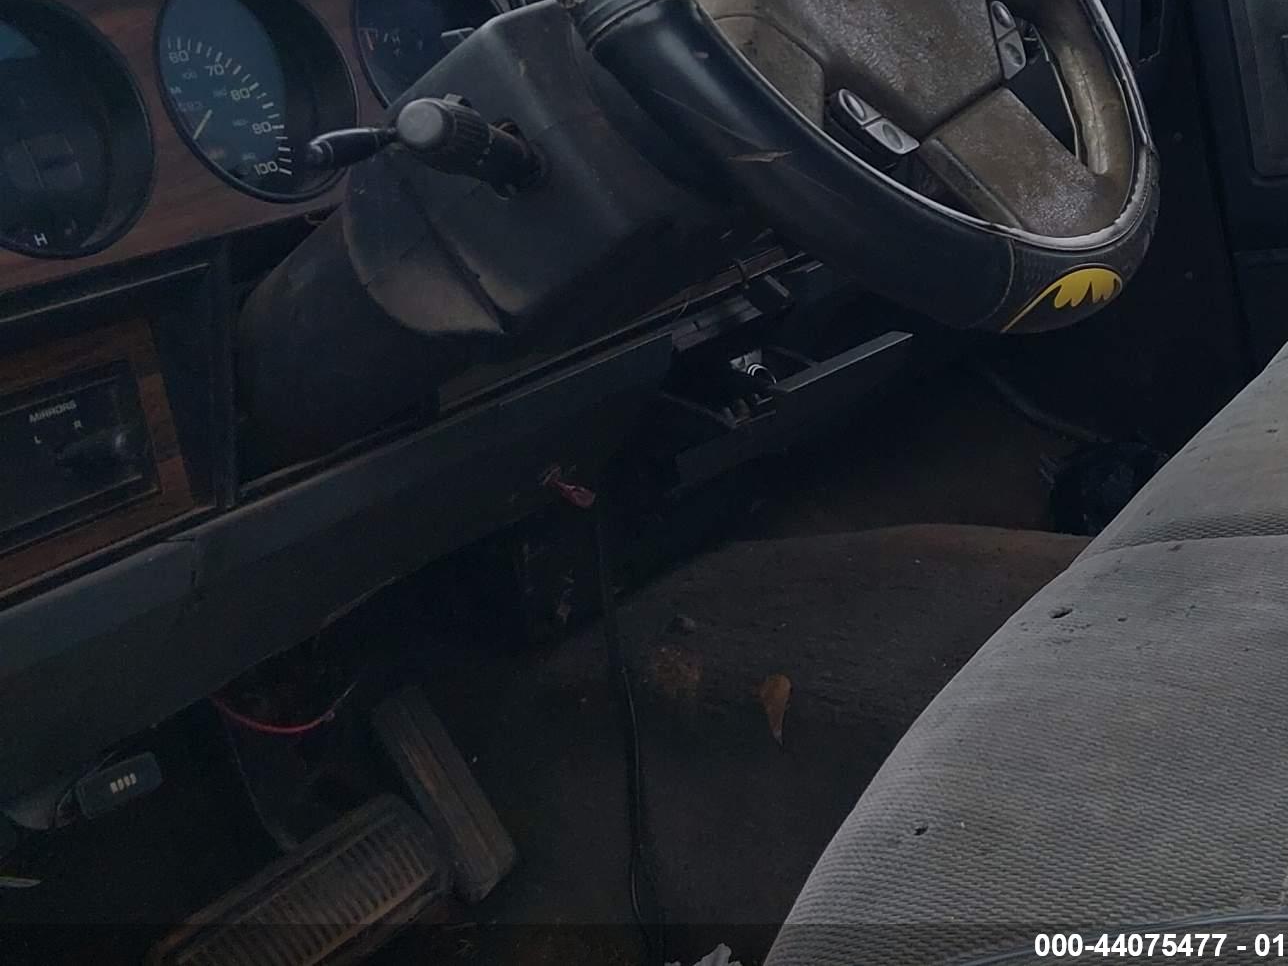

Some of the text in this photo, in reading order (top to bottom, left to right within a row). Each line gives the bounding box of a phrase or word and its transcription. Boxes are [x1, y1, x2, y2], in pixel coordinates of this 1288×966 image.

[168, 50, 189, 64] 60
[204, 64, 225, 77] 70
[230, 87, 251, 102] 80
[251, 121, 272, 135] 90
[253, 160, 279, 176] 100
[33, 232, 48, 247] H
[28, 398, 77, 424] MIRRORS
